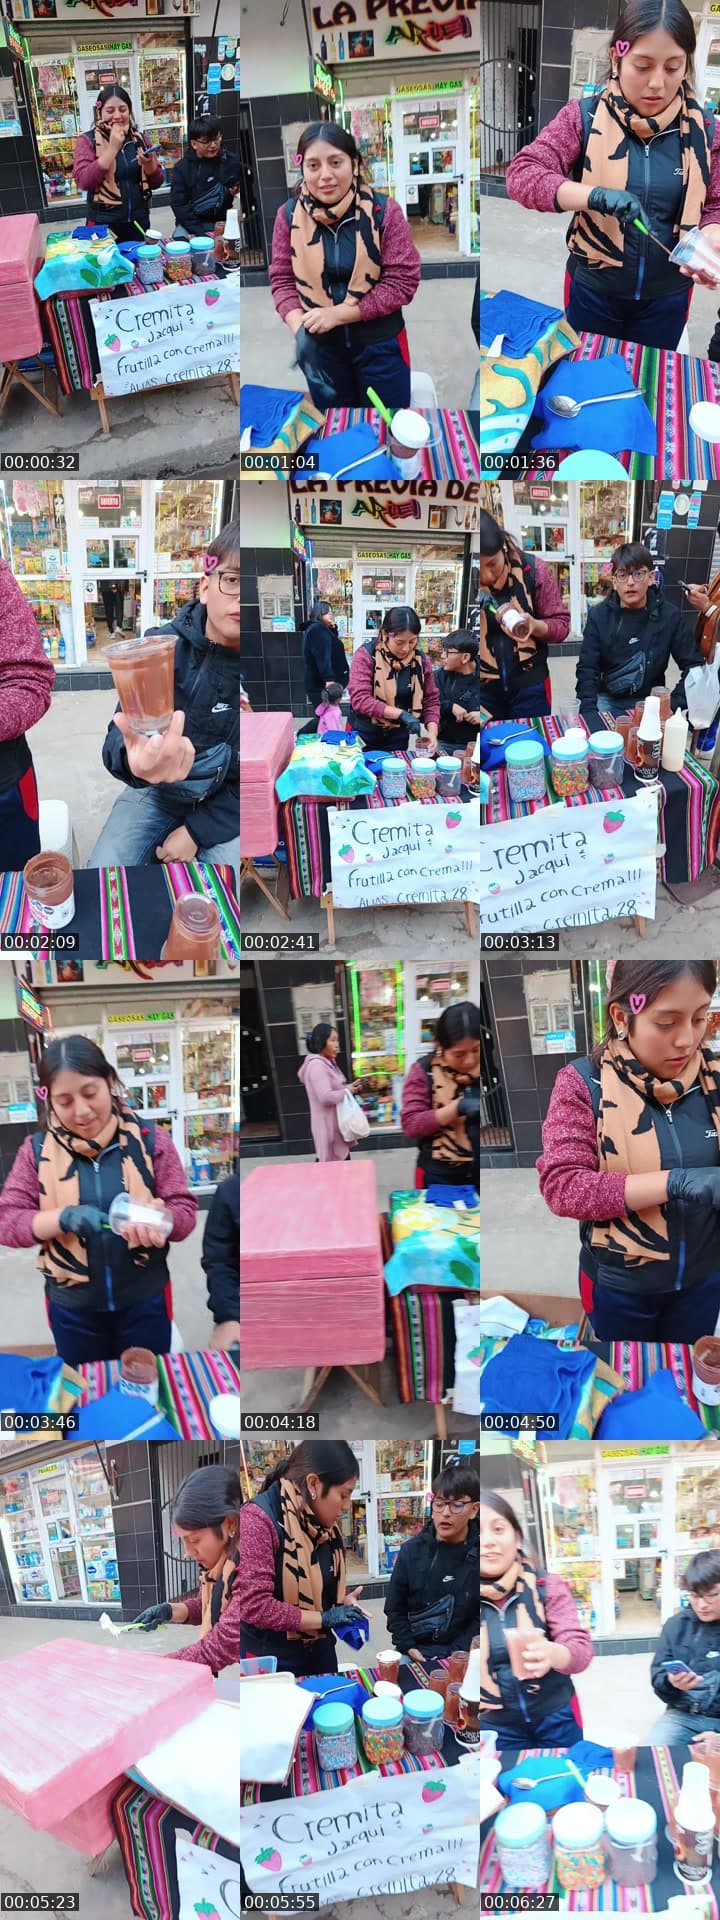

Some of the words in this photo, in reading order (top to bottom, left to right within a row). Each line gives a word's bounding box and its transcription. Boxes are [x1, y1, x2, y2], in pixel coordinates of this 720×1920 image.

[312, 1, 357, 29] LA
[115, 303, 195, 333] Cremita
[163, 348, 183, 360] con
[445, 480, 480, 503] DE
[357, 551, 387, 559] GASEOSAS
[351, 820, 434, 845] Cremita
[480, 831, 587, 872] remita
[397, 867, 417, 879] con
[480, 898, 536, 925] rutilla
[540, 886, 568, 903] con
[271, 1801, 404, 1844] Cremita
[353, 1856, 383, 1872] con
